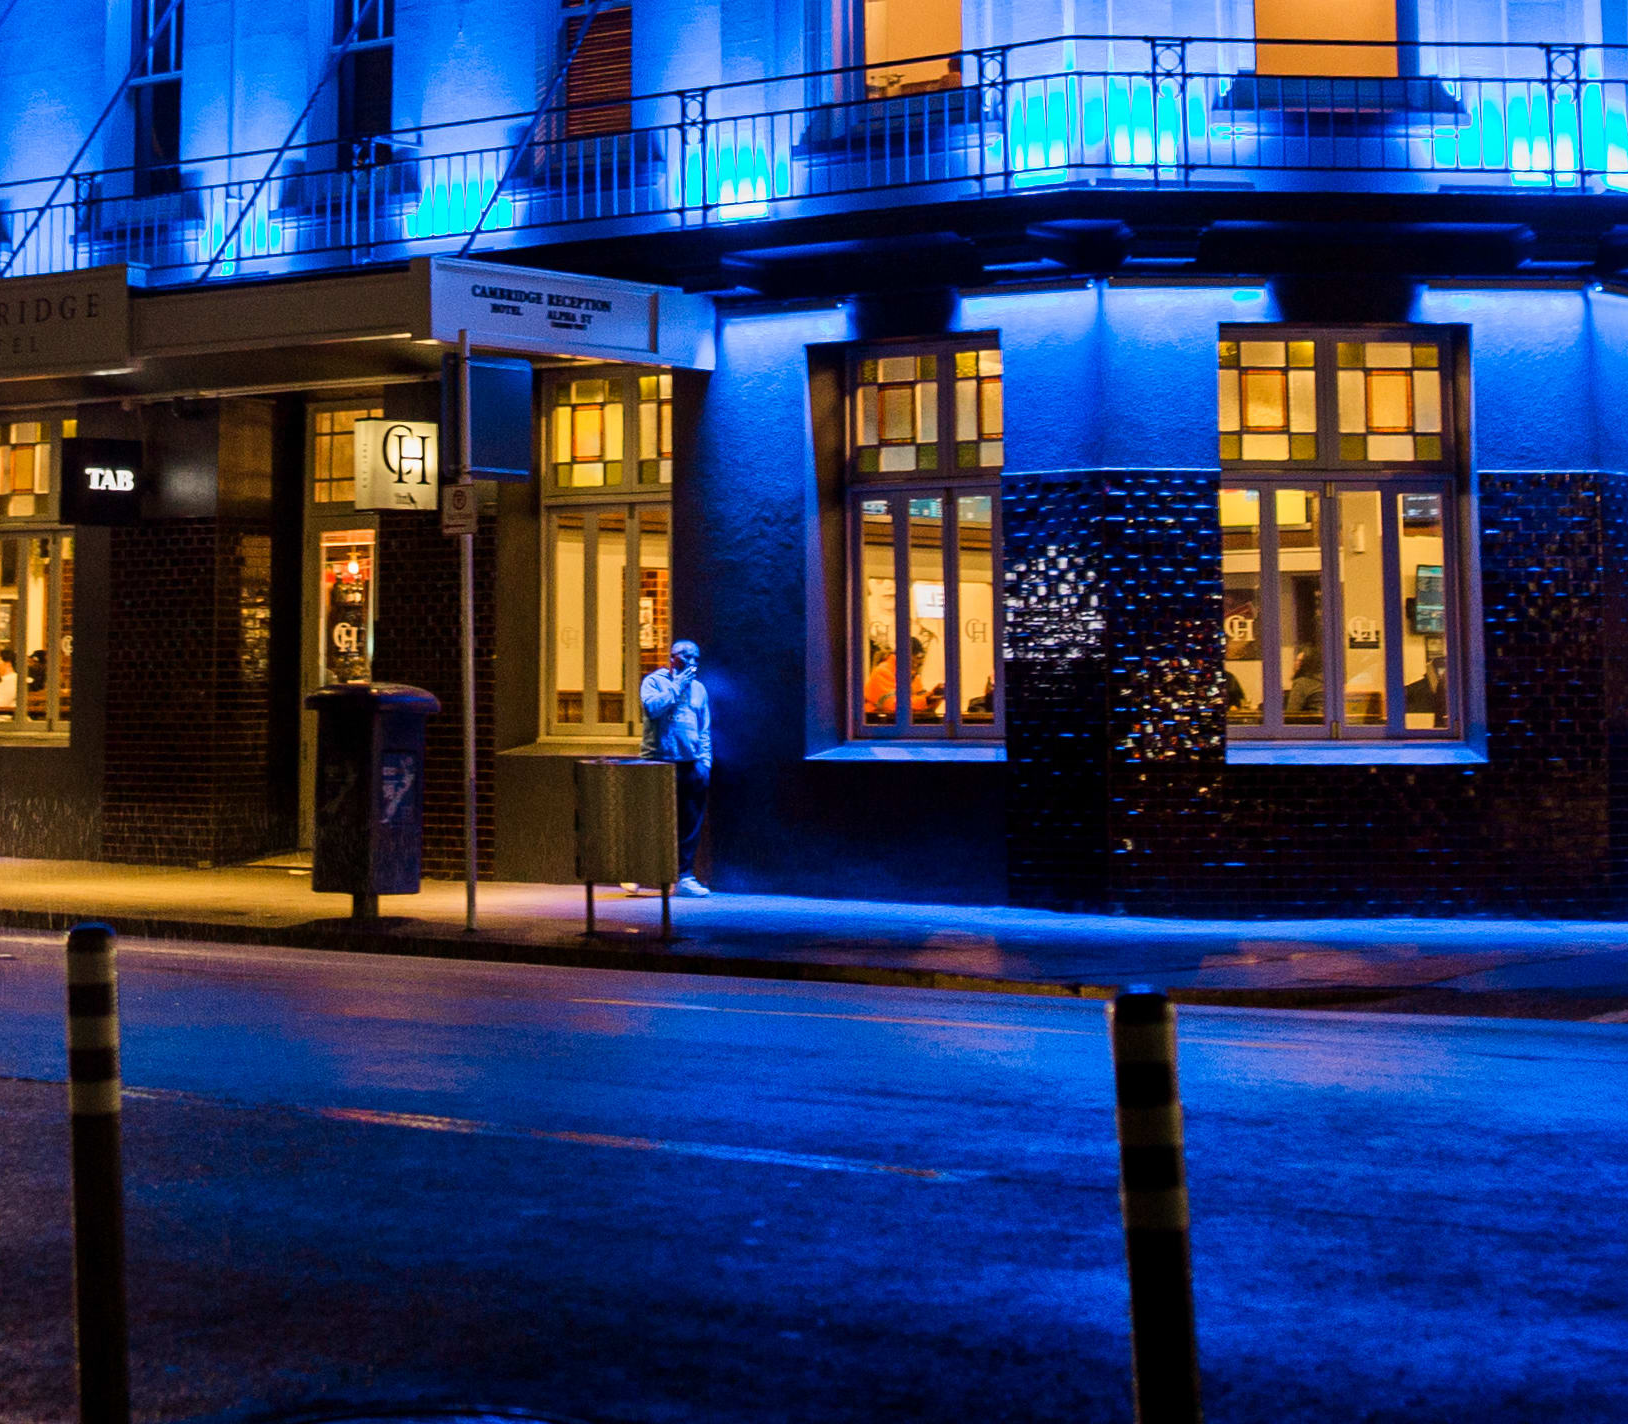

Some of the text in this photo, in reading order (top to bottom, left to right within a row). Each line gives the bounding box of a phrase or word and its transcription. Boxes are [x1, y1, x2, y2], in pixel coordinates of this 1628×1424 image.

[472, 284, 612, 313] CAMBRIDGE RECEPTION
[491, 303, 523, 316] HOTEL
[547, 310, 593, 325] ALPHA ST
[382, 424, 432, 486] CH
[84, 467, 135, 492] TAB
[333, 622, 359, 653] CH
[965, 618, 988, 643] CH
[1224, 614, 1256, 643] CH
